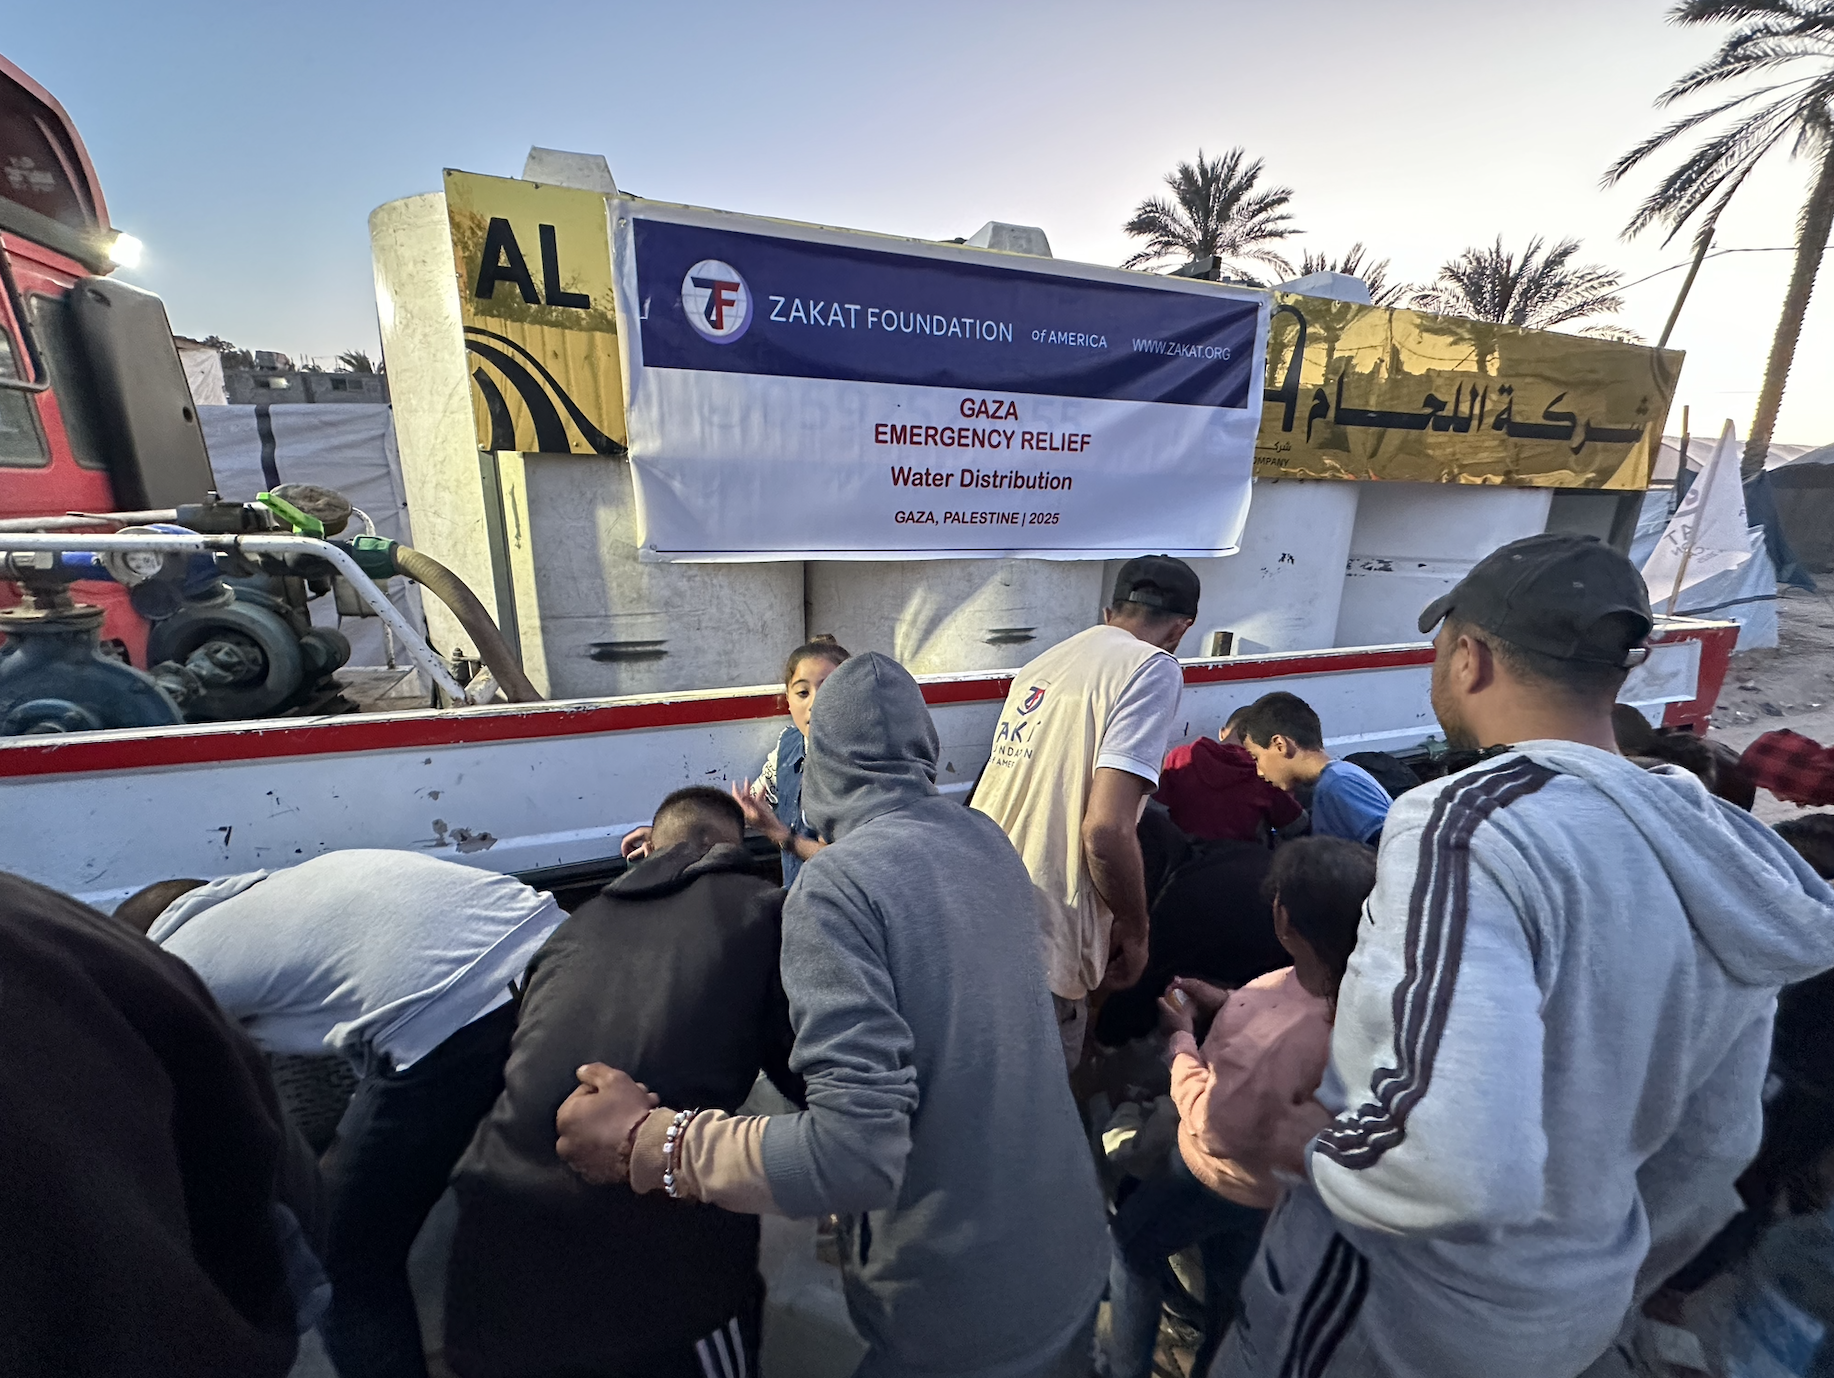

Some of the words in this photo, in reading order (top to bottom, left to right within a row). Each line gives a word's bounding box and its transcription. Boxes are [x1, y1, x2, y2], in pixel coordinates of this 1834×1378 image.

[475, 217, 591, 310] AL
[768, 295, 861, 329] ZAKAT
[867, 308, 1013, 343] FOUNDATION
[1031, 329, 1047, 343] of
[1048, 330, 1108, 348] AMERICA
[1132, 337, 1231, 360] WWW.ZAKAT.ORG
[959, 397, 1019, 421] GAZA
[1306, 369, 1489, 444] اللحام
[1491, 383, 1651, 455] شركة
[874, 423, 1016, 450] EMERGENCY
[1021, 431, 1092, 453] RELIEF
[890, 465, 955, 488] Water
[960, 468, 1073, 491] Distribution
[894, 510, 939, 527] GAZA,
[943, 511, 1020, 525] PALESTINE
[1028, 512, 1060, 525] 2025
